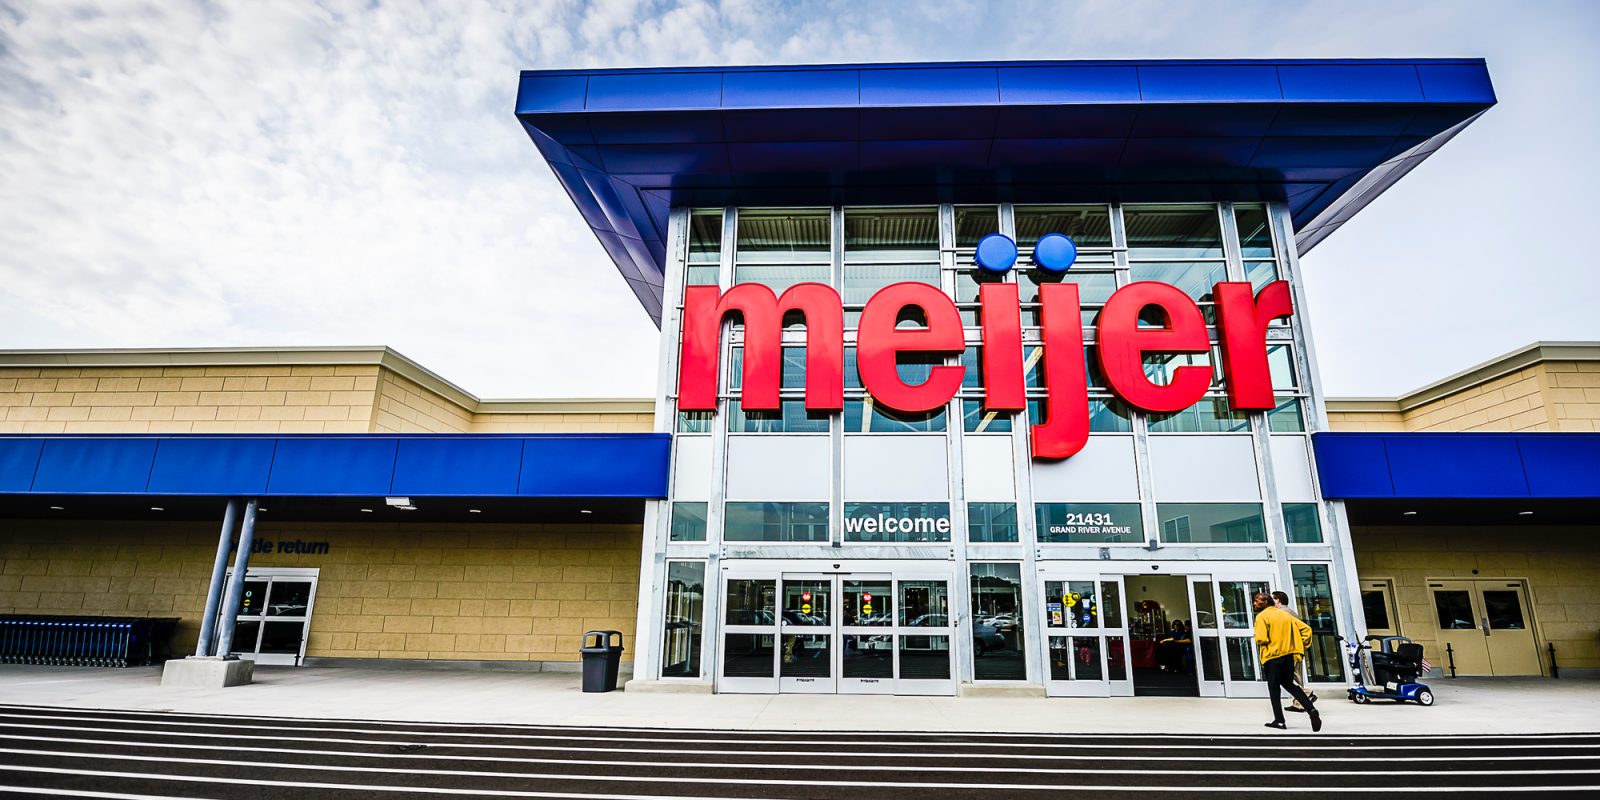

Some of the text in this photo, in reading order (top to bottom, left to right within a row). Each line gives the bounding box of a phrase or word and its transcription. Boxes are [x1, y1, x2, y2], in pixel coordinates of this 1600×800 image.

[677, 233, 1294, 460] meijer
[844, 513, 950, 533] welcome
[1066, 513, 1114, 526] 21431
[1050, 526, 1131, 534] GRAND RIVER AVENUE
[277, 538, 330, 554] return
